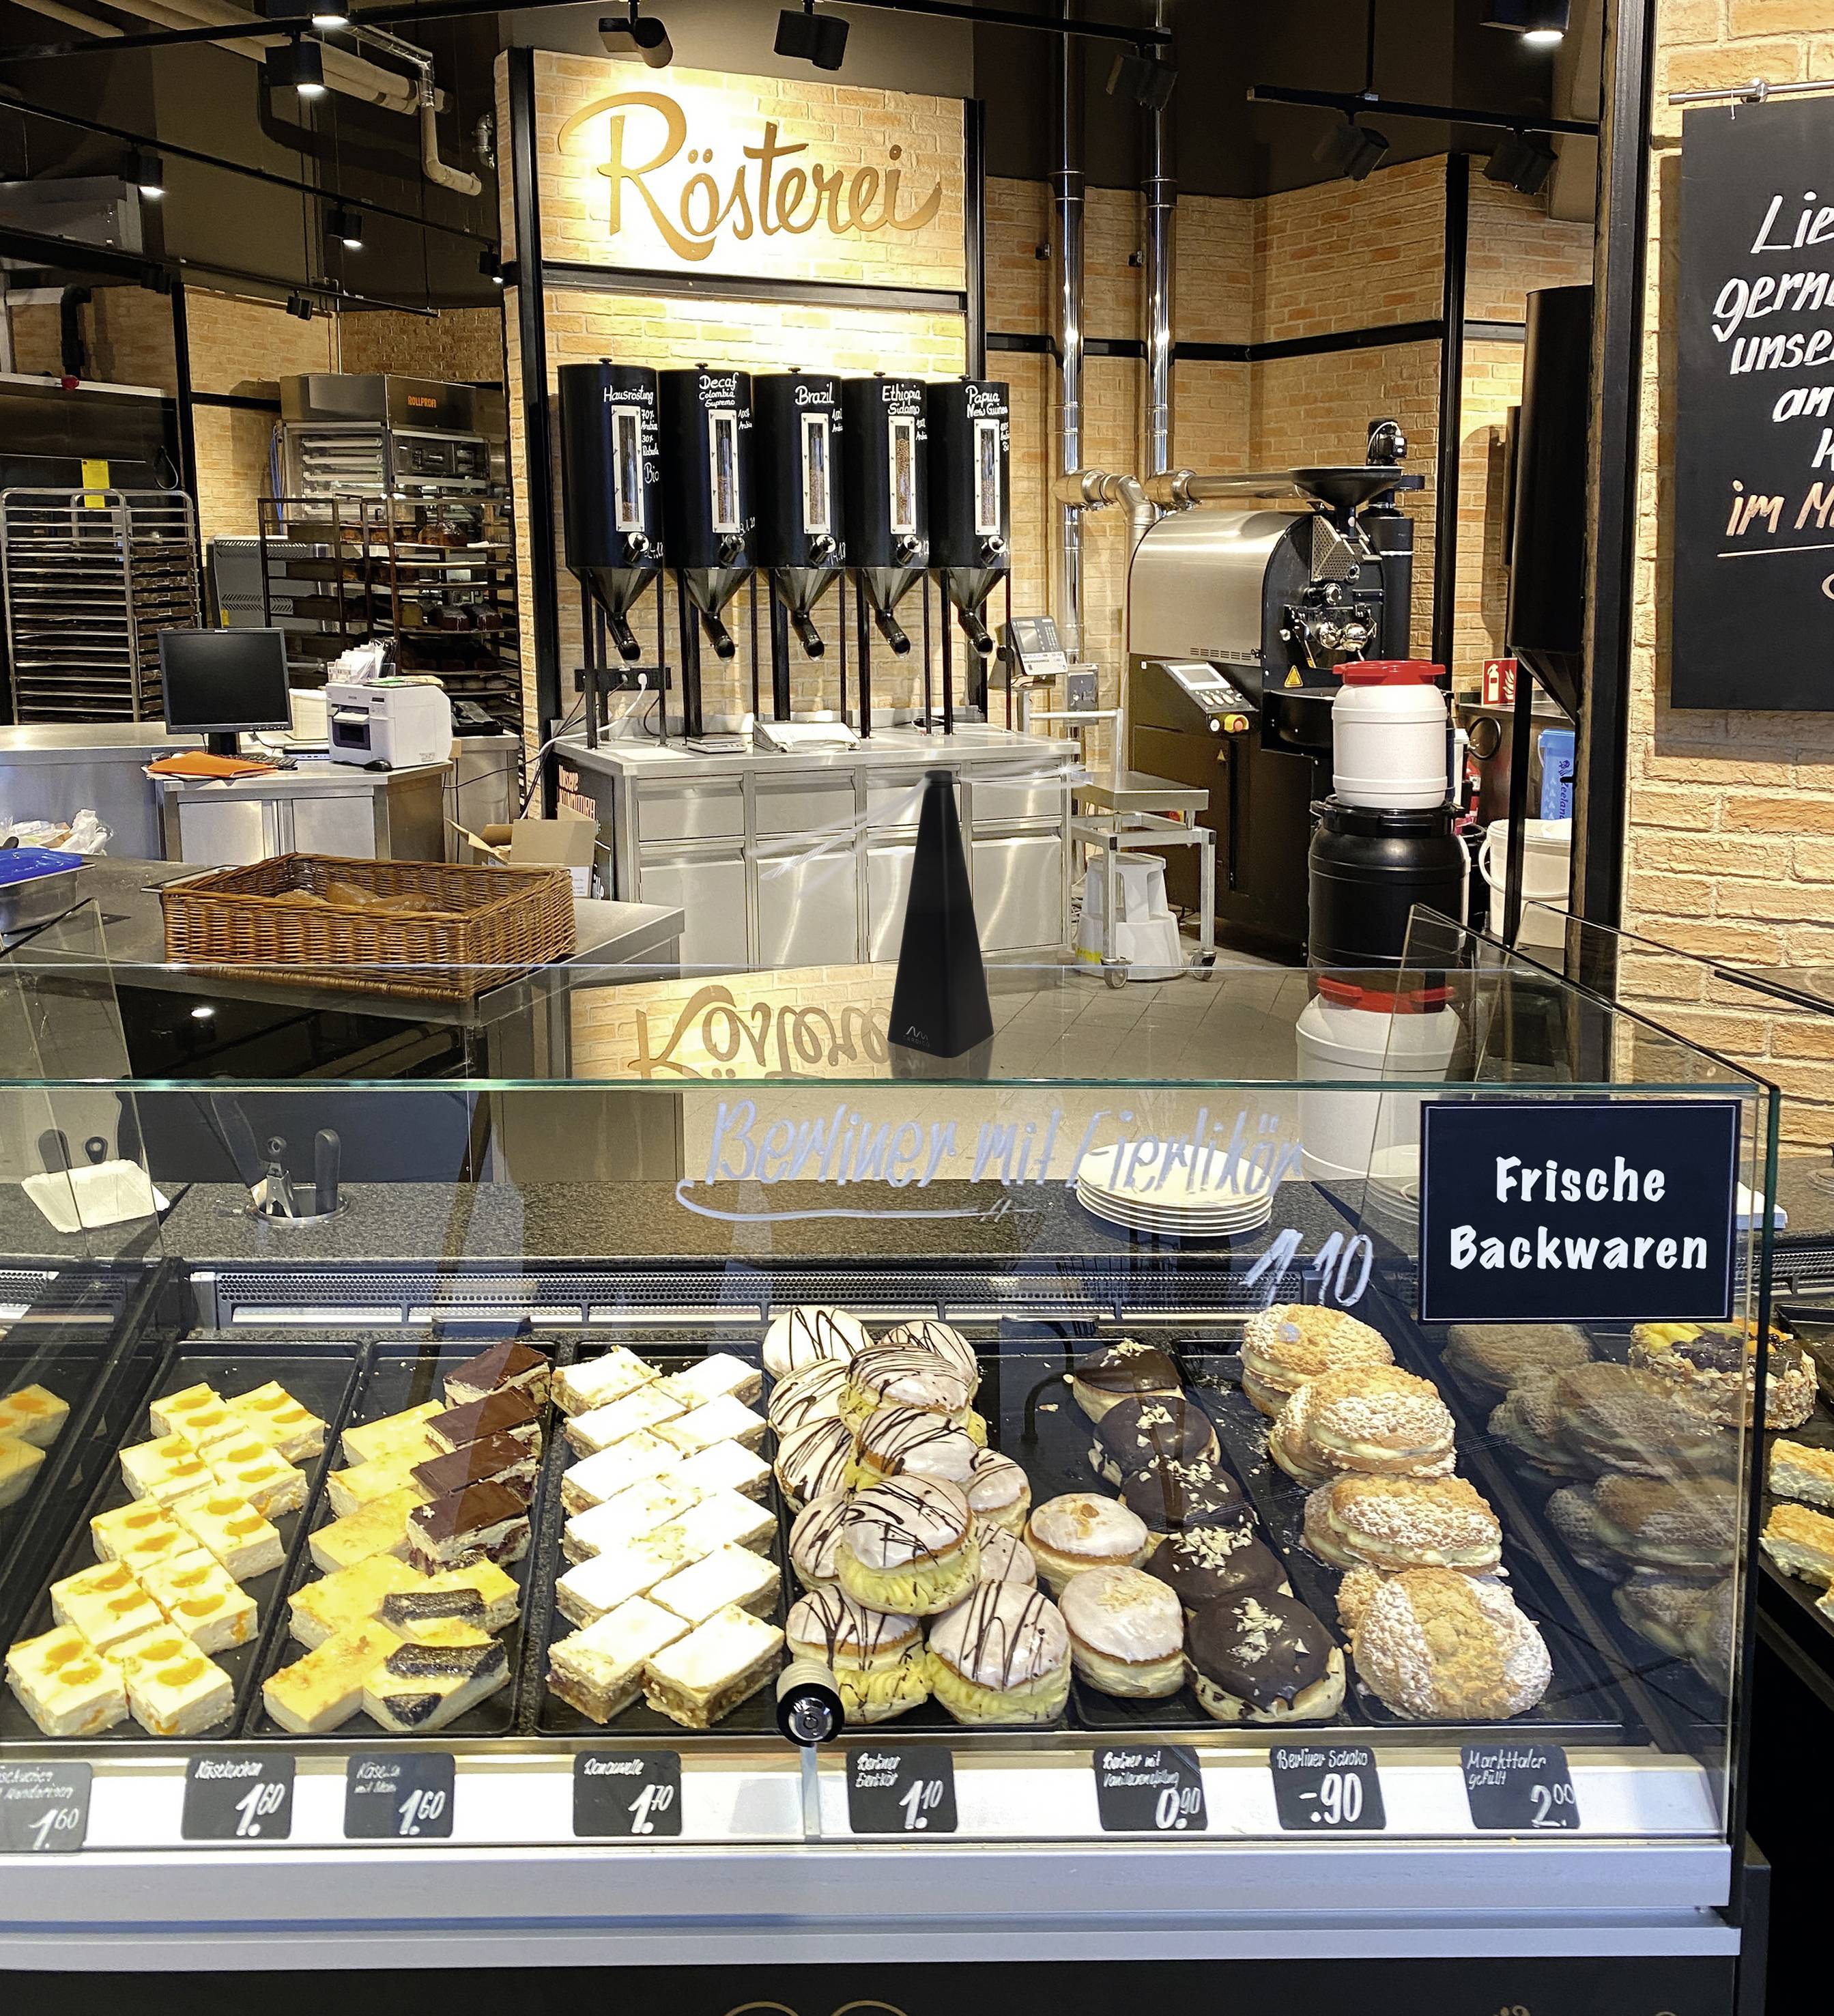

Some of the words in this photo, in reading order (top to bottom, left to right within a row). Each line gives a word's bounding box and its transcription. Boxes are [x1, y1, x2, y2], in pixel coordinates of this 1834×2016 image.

[558, 91, 942, 261] Rösterei
[1730, 329, 1834, 375] unse
[699, 372, 739, 391] Decaf
[603, 385, 654, 405] Hausröstung
[699, 388, 736, 400] Colombia
[704, 399, 735, 408] Supremo
[795, 382, 835, 405] Brazil
[882, 383, 921, 406] Ethiopia
[965, 385, 1001, 408] Papua
[887, 401, 920, 415] Sidamo
[966, 403, 986, 418] New
[644, 462, 659, 484] Bio
[1726, 479, 1785, 536] im
[704, 1098, 956, 1188] Berliner
[970, 1109, 1061, 1184] mit
[1065, 1106, 1305, 1196] Eierlikör
[1496, 1156, 1665, 1202] Frische
[1450, 1225, 1707, 1269] Backwaren
[1277, 1748, 1326, 1770] Berliner
[1467, 1748, 1547, 1770] Markttaler
[1468, 1769, 1506, 1790] gefüllt
